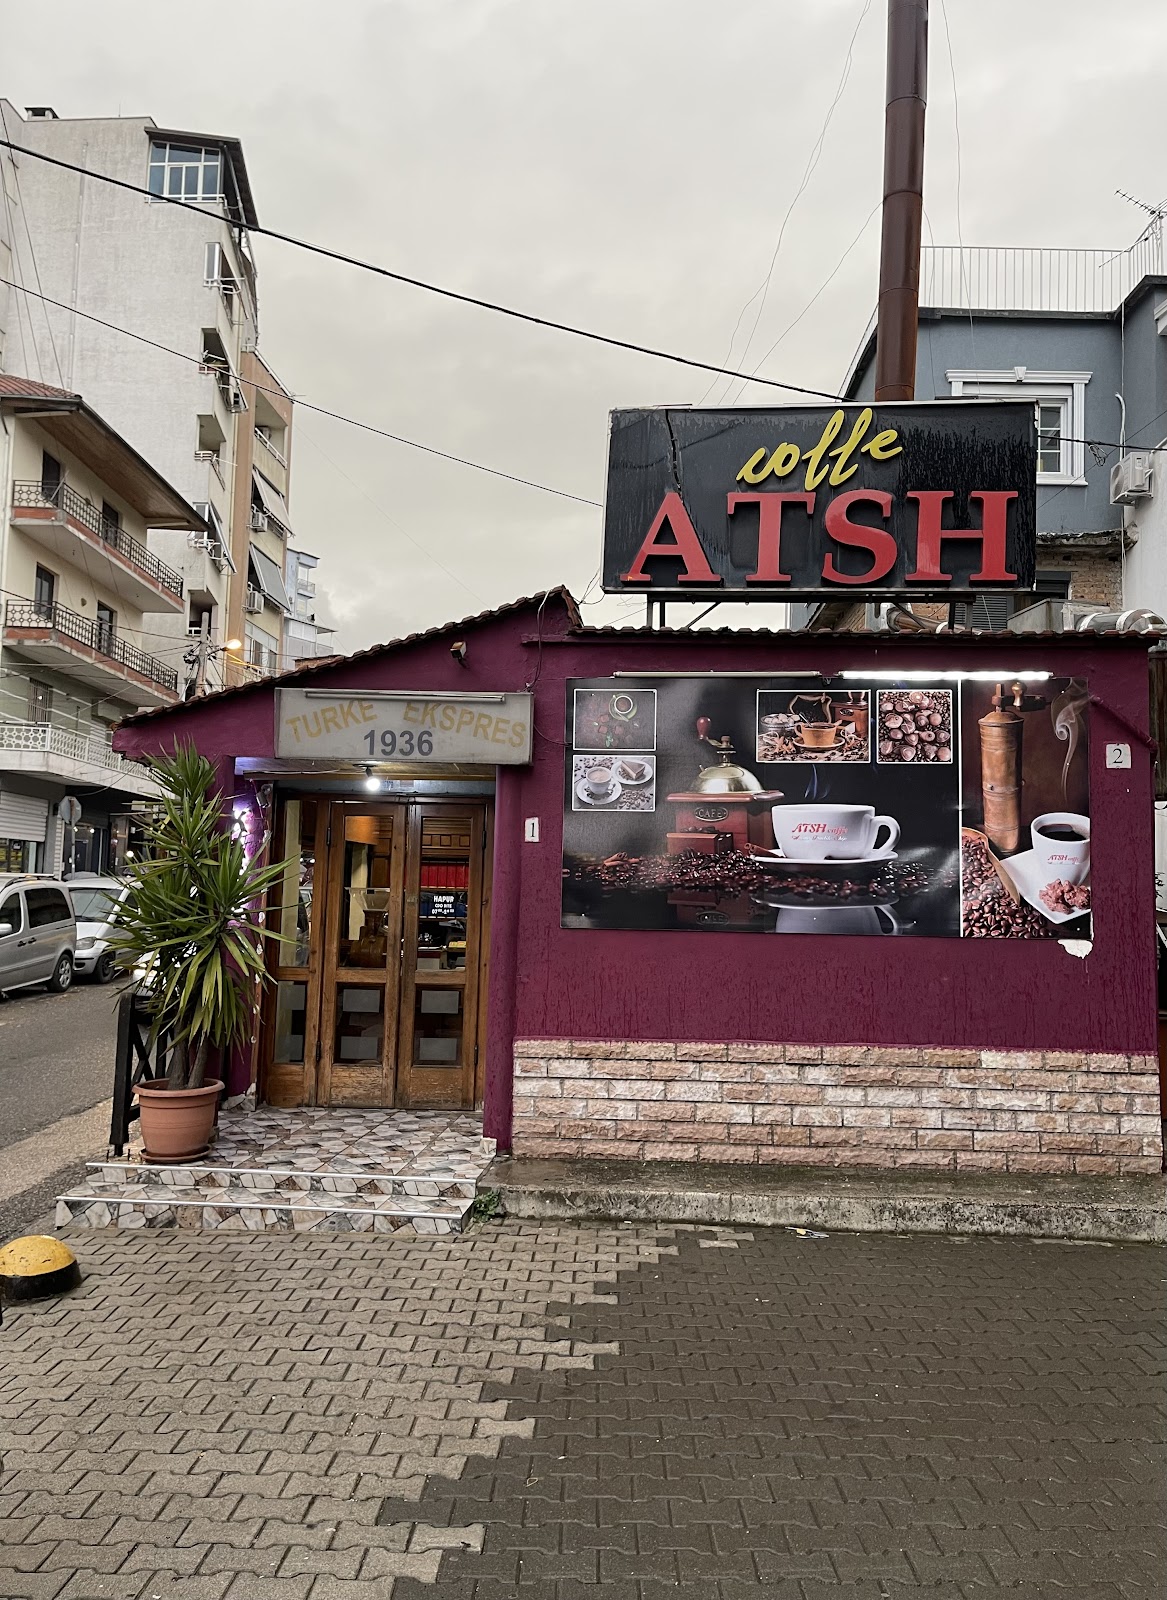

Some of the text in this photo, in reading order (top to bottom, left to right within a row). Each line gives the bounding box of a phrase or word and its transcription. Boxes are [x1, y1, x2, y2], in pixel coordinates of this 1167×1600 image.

[620, 489, 1019, 584] ATSH
[285, 700, 527, 747] TURKE EKSPRES
[363, 729, 433, 756] 1936
[1112, 748, 1123, 764] 2
[530, 822, 535, 838] 1
[791, 823, 827, 833] ATSH
